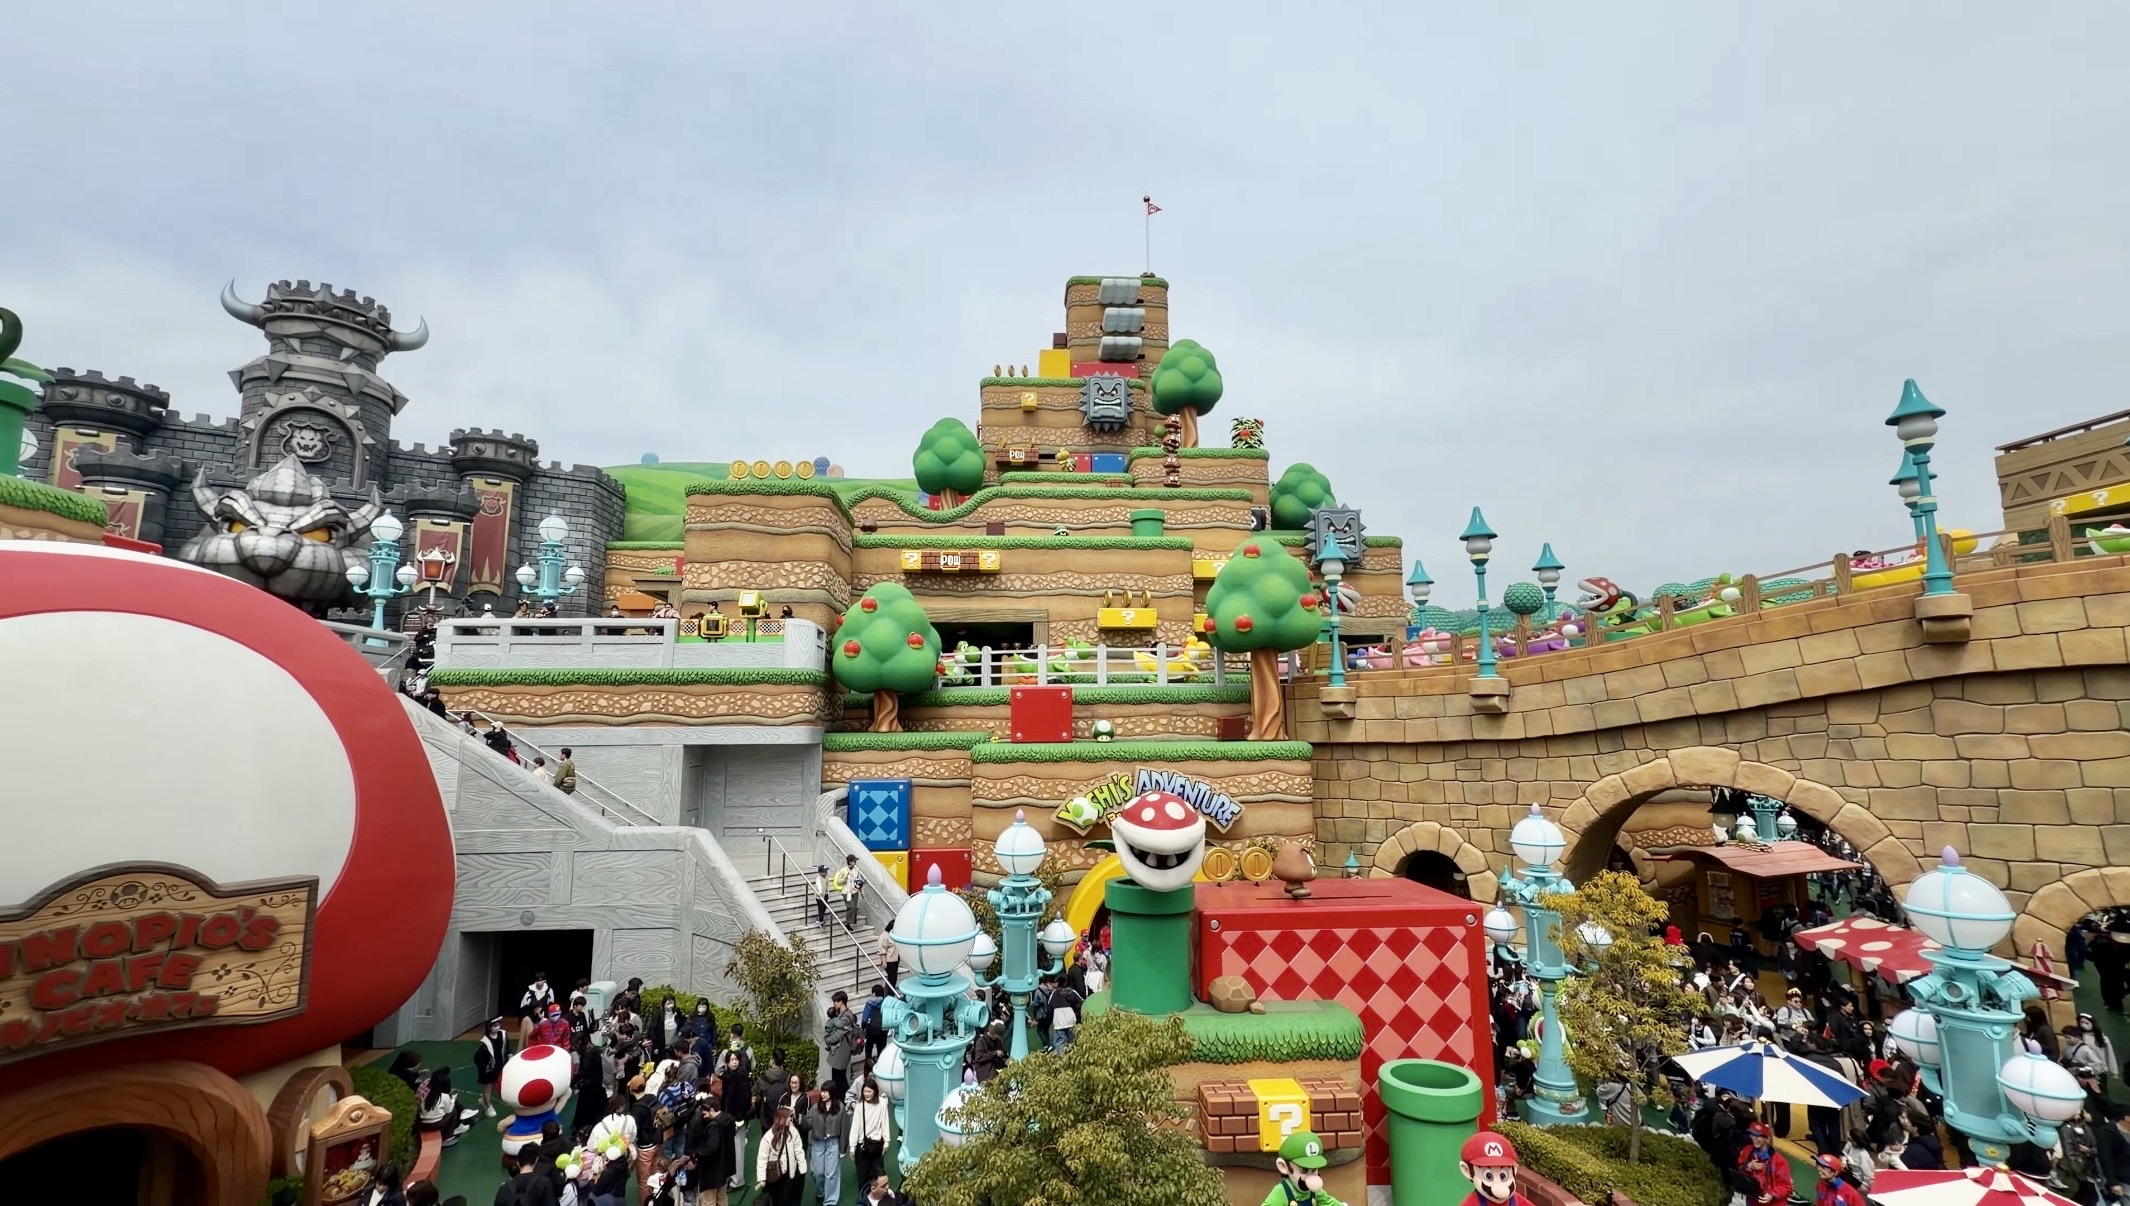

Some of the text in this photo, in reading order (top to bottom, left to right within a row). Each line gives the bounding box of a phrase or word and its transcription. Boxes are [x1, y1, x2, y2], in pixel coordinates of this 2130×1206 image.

[940, 554, 960, 566] POW
[1136, 768, 1242, 828] ADVENTURE
[31, 951, 203, 1010] CAFE
[1487, 1144, 1502, 1155] M
